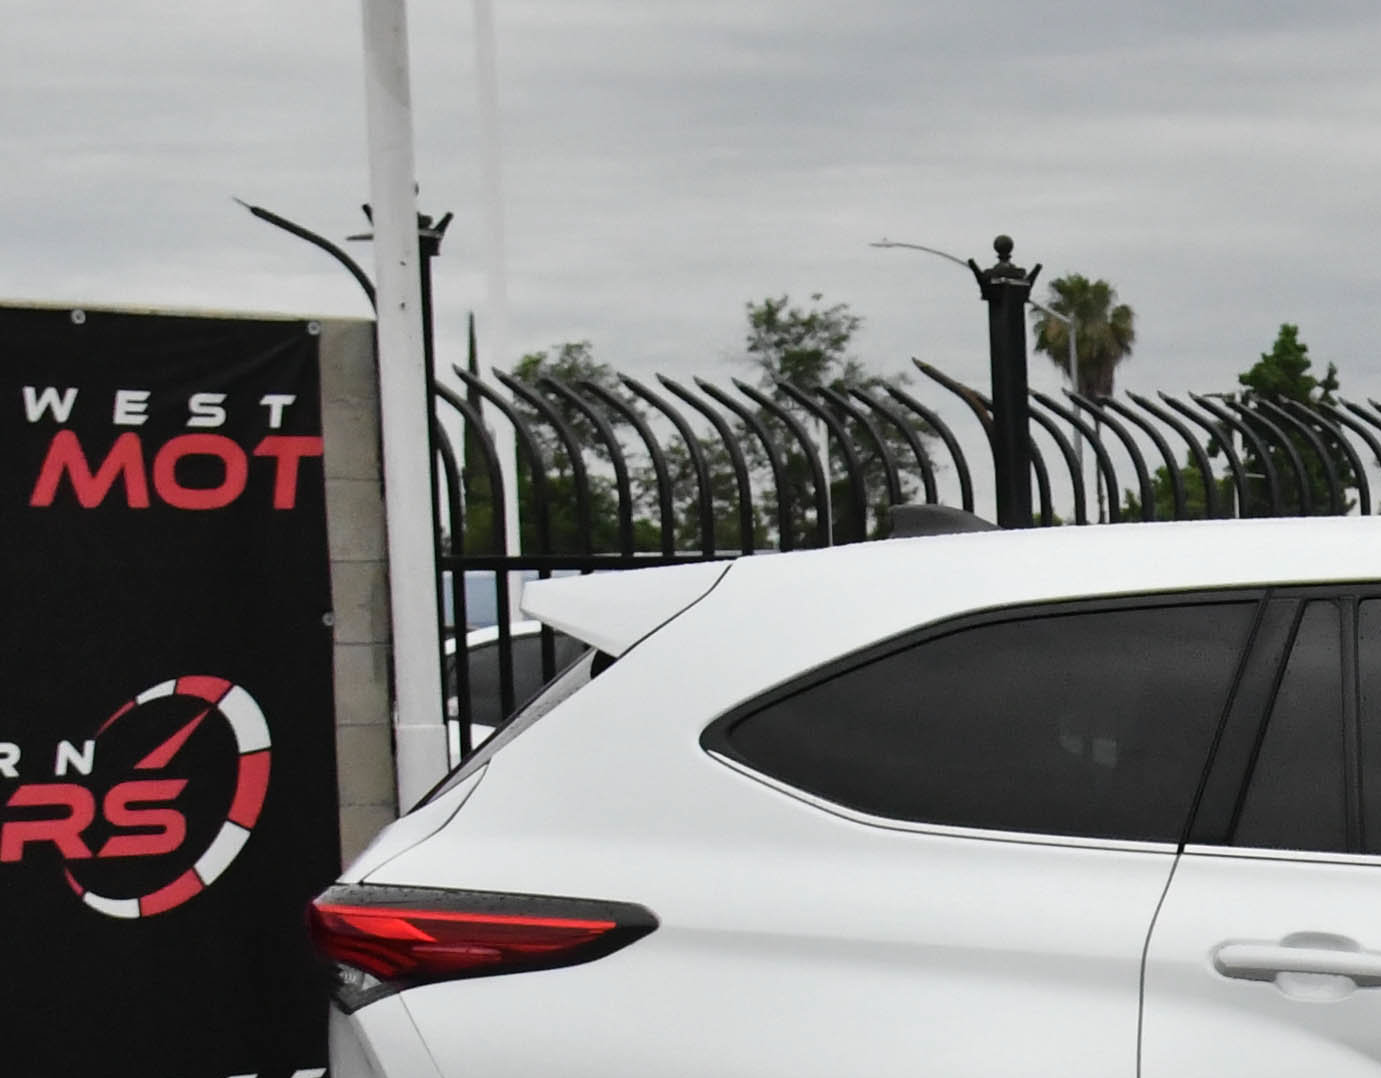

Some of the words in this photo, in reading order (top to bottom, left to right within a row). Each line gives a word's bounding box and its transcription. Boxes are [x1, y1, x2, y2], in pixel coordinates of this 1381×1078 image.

[23, 386, 296, 428] WEST
[30, 429, 323, 510] MOT
[0, 779, 188, 862] RS
